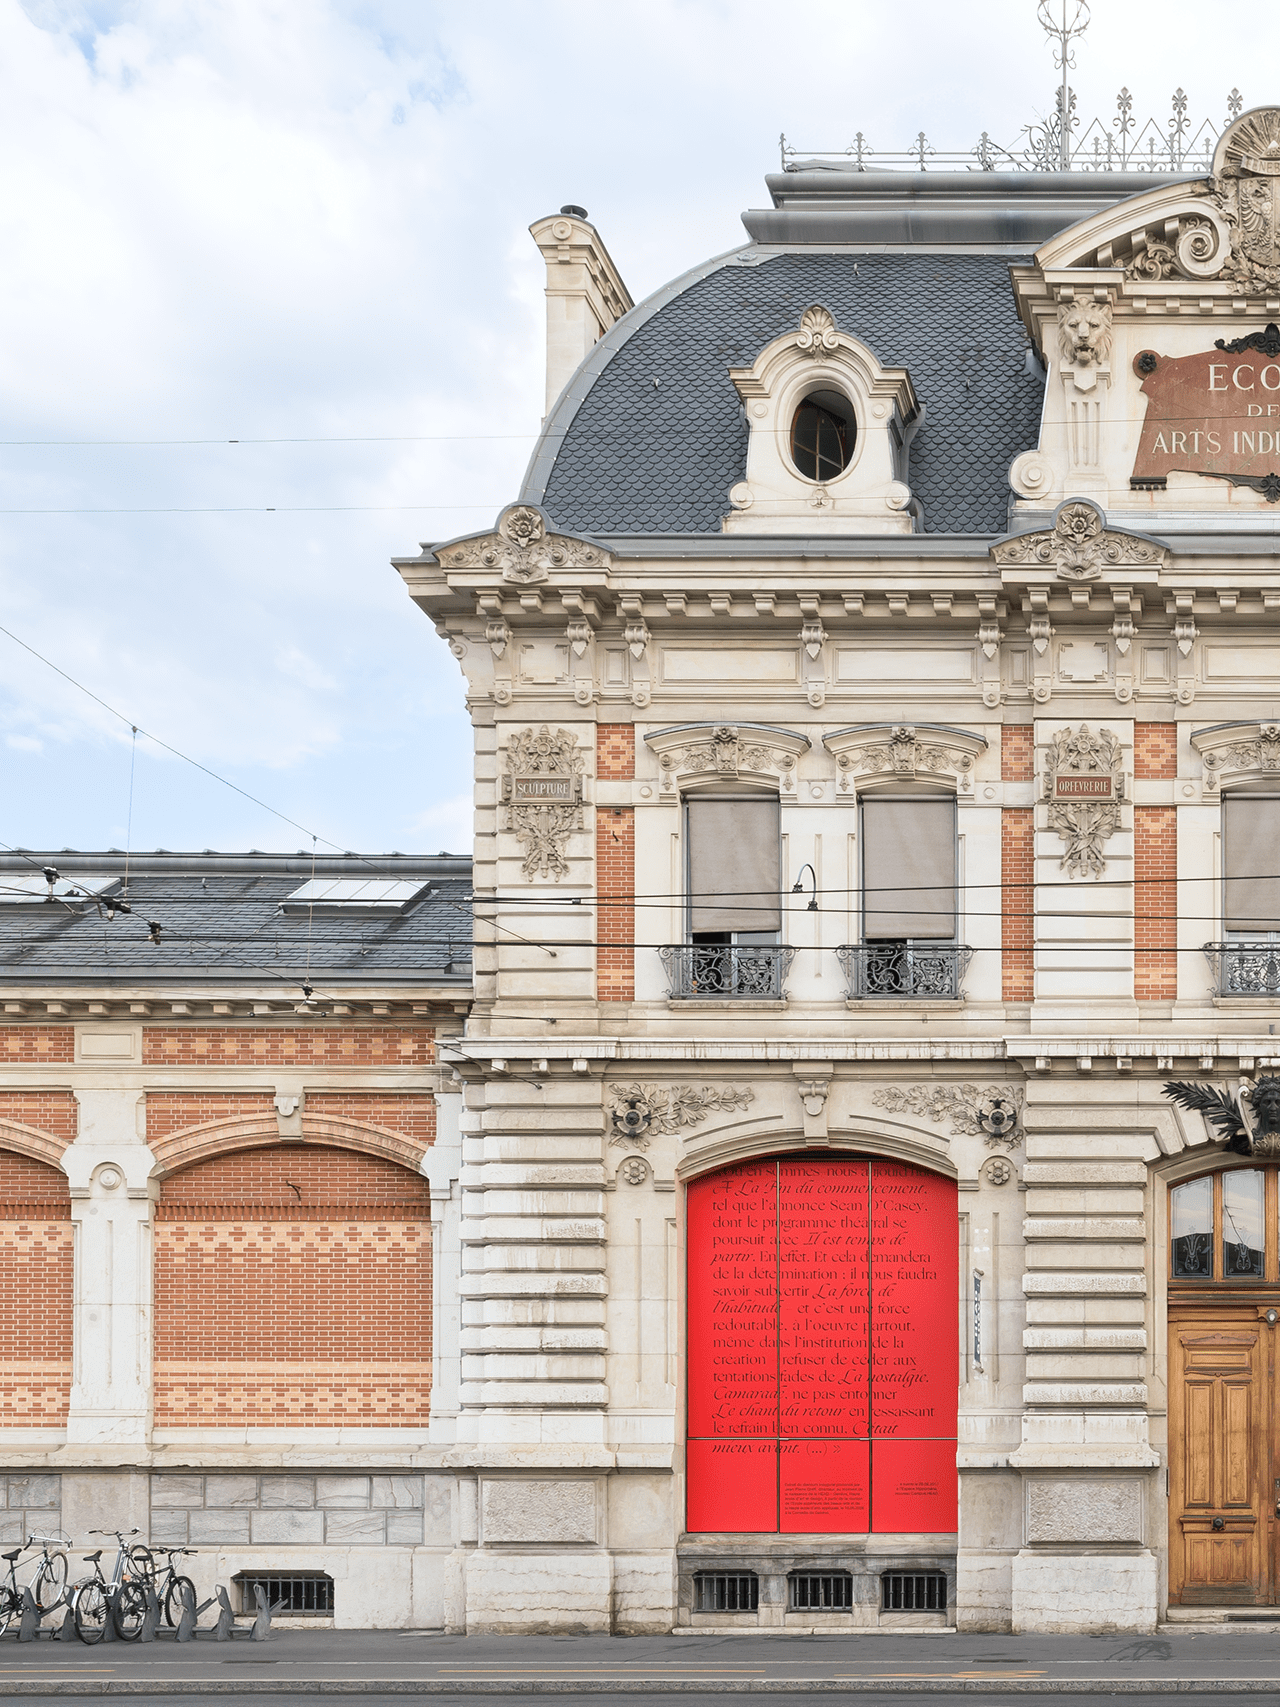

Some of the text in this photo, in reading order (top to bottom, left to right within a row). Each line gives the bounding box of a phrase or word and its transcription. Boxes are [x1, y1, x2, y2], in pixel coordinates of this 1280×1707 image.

[1152, 431, 1221, 454] ARTS
[517, 782, 569, 794] SCULPTURE
[1058, 781, 1109, 793] ORFEVRERIE
[734, 1180, 759, 1197] La
[795, 1179, 814, 1194] du
[712, 1198, 728, 1211] tel
[732, 1202, 757, 1214] que
[830, 1200, 862, 1211] Sean
[712, 1215, 742, 1228] dont
[747, 1215, 758, 1228] le
[762, 1219, 837, 1232] programme
[892, 1219, 908, 1228] se
[713, 1233, 765, 1248] poursuit
[823, 1236, 842, 1246] est
[889, 1231, 908, 1246] de
[760, 1251, 776, 1262] En
[814, 1251, 827, 1262] Et
[831, 1250, 856, 1262] cela
[860, 1250, 931, 1262] demandera
[713, 1267, 730, 1279] de
[733, 1267, 745, 1279] la
[748, 1267, 838, 1279] détermination
[850, 1267, 857, 1279] il
[861, 1270, 893, 1280] nous
[897, 1267, 937, 1280] faudra
[713, 1285, 750, 1297] savoir
[812, 1283, 838, 1299] La
[877, 1283, 897, 1297] de
[797, 1303, 809, 1314] et
[813, 1302, 844, 1314] c'est
[849, 1304, 873, 1314] une
[878, 1302, 910, 1314] force
[792, 1319, 800, 1331] à
[805, 1318, 858, 1331] l'oeuvre
[713, 1336, 904, 1348] même dans l'institution de la
[713, 1353, 917, 1365] création refuser de céder aux
[713, 1371, 776, 1382] tentations
[780, 1370, 815, 1382] fades
[818, 1370, 836, 1382] de
[838, 1369, 863, 1385] La
[792, 1390, 808, 1400] ne
[813, 1390, 836, 1404] pas
[711, 1402, 735, 1419] Le
[739, 1402, 779, 1416] chant
[781, 1402, 800, 1416] du
[802, 1407, 845, 1417] retour
[849, 1407, 865, 1417] en
[713, 1421, 724, 1433] le
[729, 1421, 768, 1433] refrain
[712, 1442, 754, 1454] mieux
